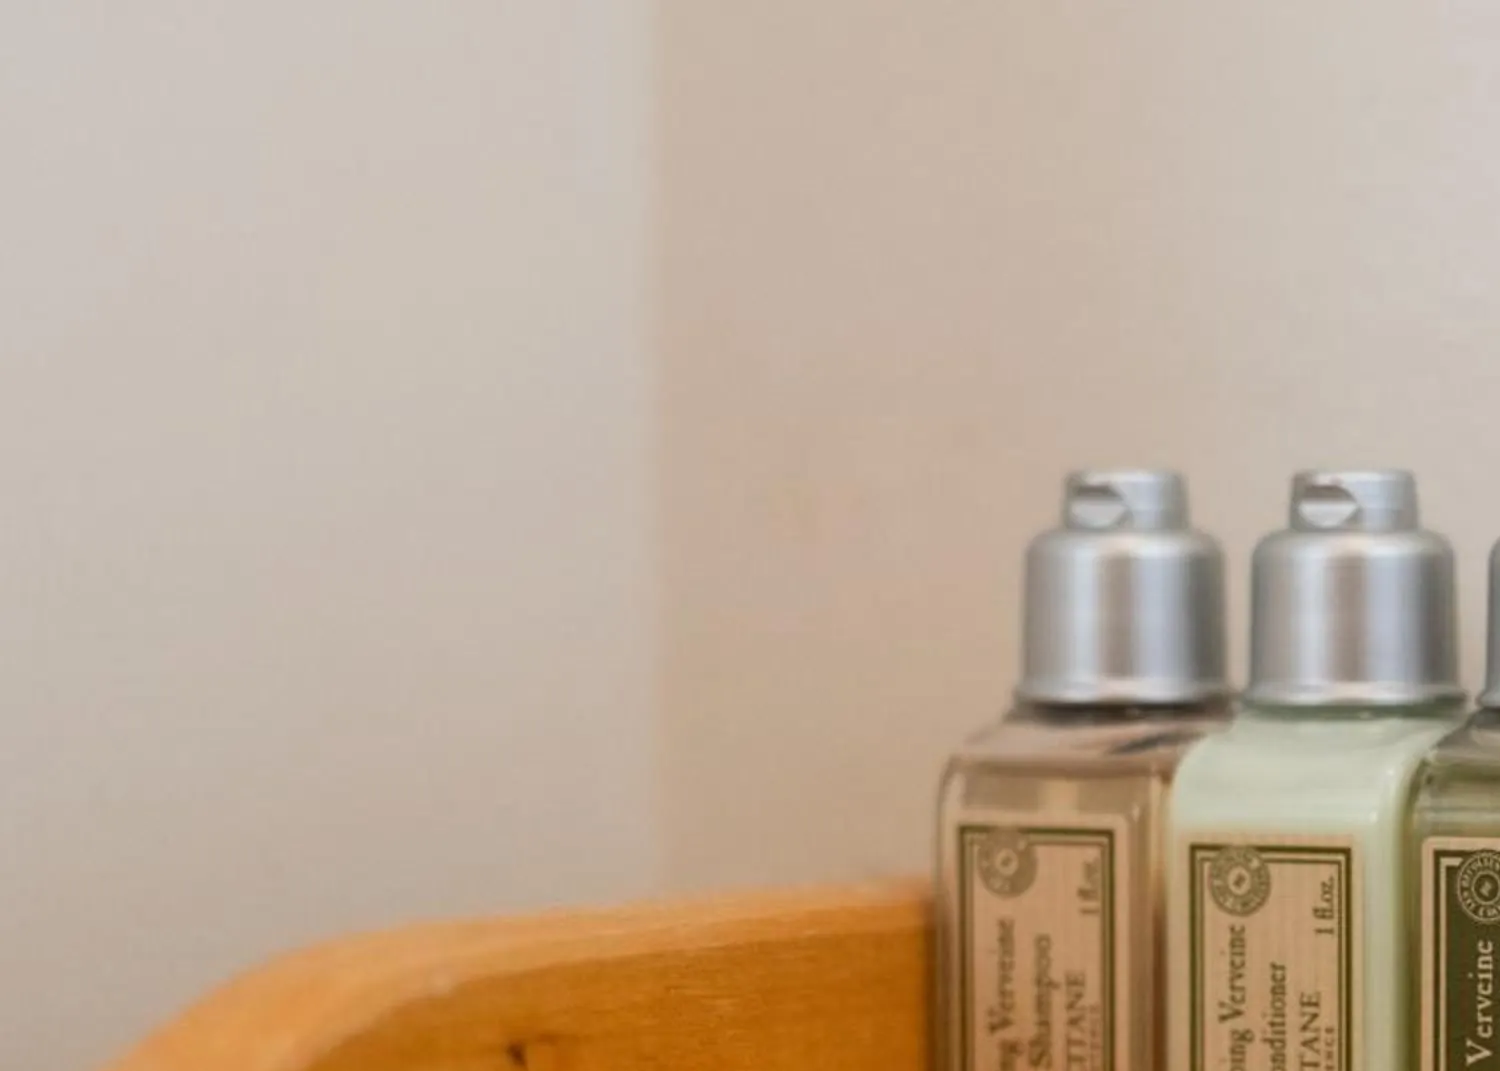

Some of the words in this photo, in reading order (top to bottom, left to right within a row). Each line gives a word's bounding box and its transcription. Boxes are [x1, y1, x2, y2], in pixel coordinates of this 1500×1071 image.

[1027, 936, 1060, 1071] Shampoo
[1219, 925, 1246, 1023] Verveine
[1467, 940, 1494, 1064] Verveine
